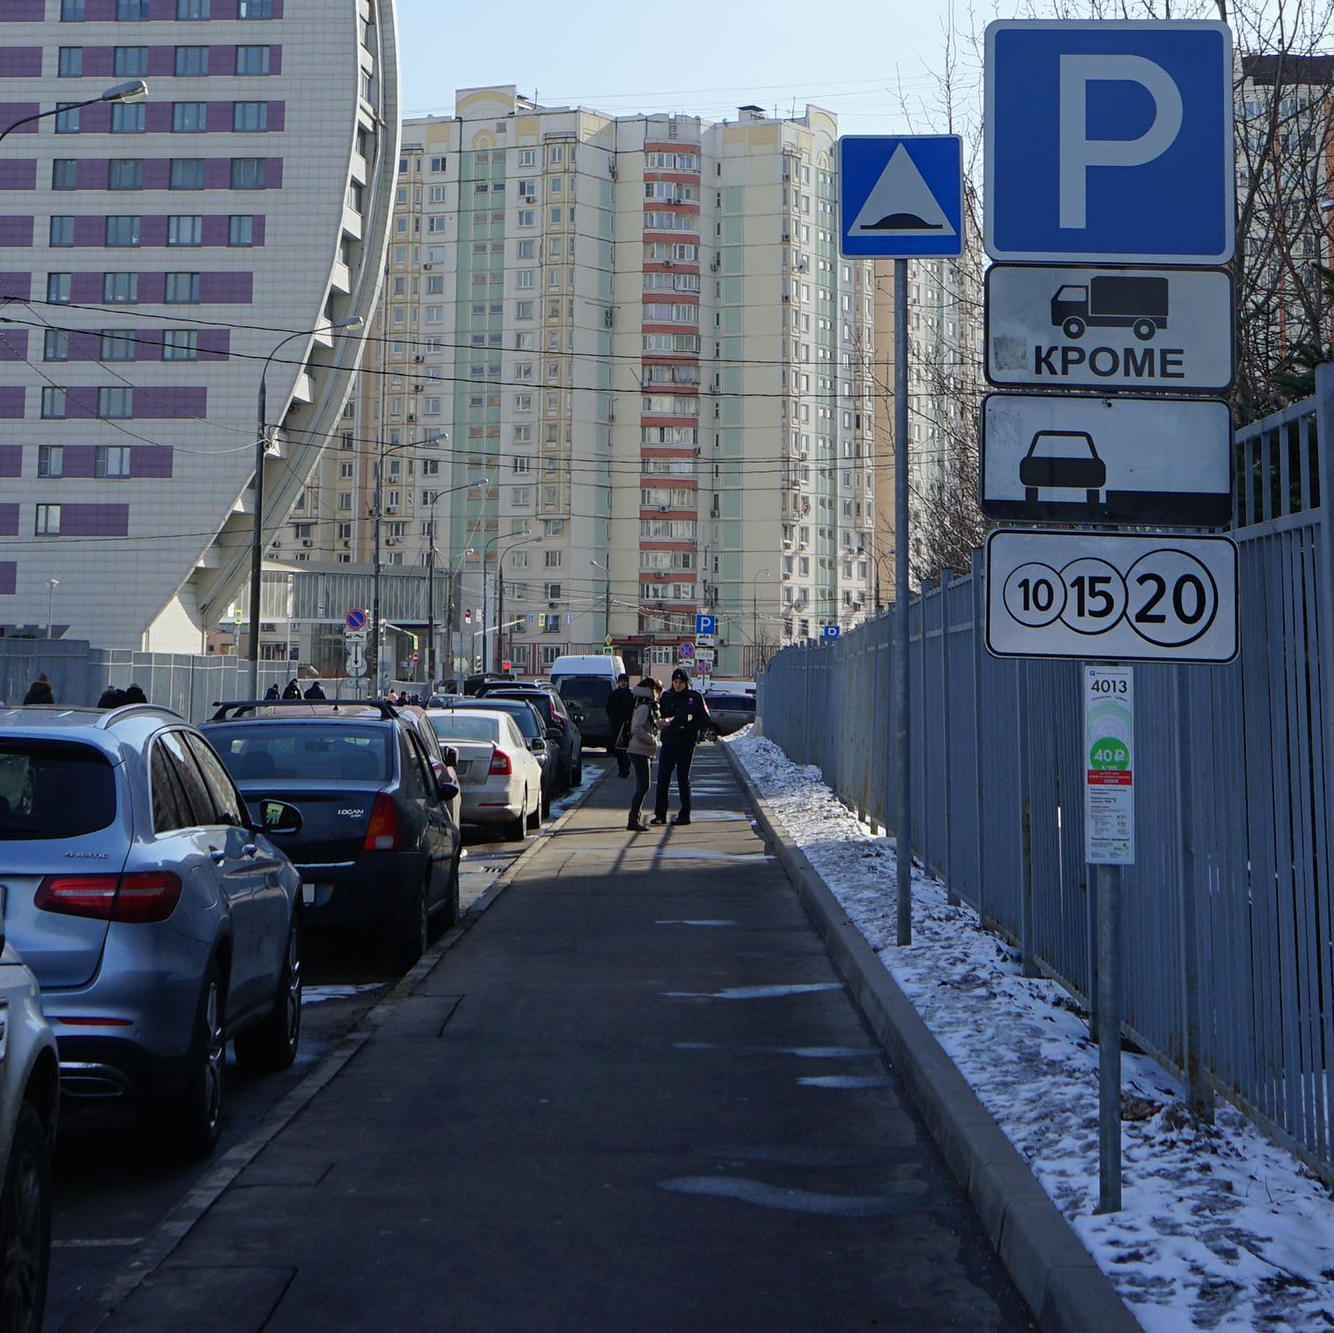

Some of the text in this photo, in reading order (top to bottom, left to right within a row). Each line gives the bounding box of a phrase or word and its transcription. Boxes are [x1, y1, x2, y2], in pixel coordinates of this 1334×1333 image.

[1059, 54, 1183, 229] P
[1035, 345, 1185, 379] КРОМЕ
[1018, 573, 1206, 624] 10 15 20
[701, 617, 711, 631] P
[1091, 679, 1127, 693] 4013
